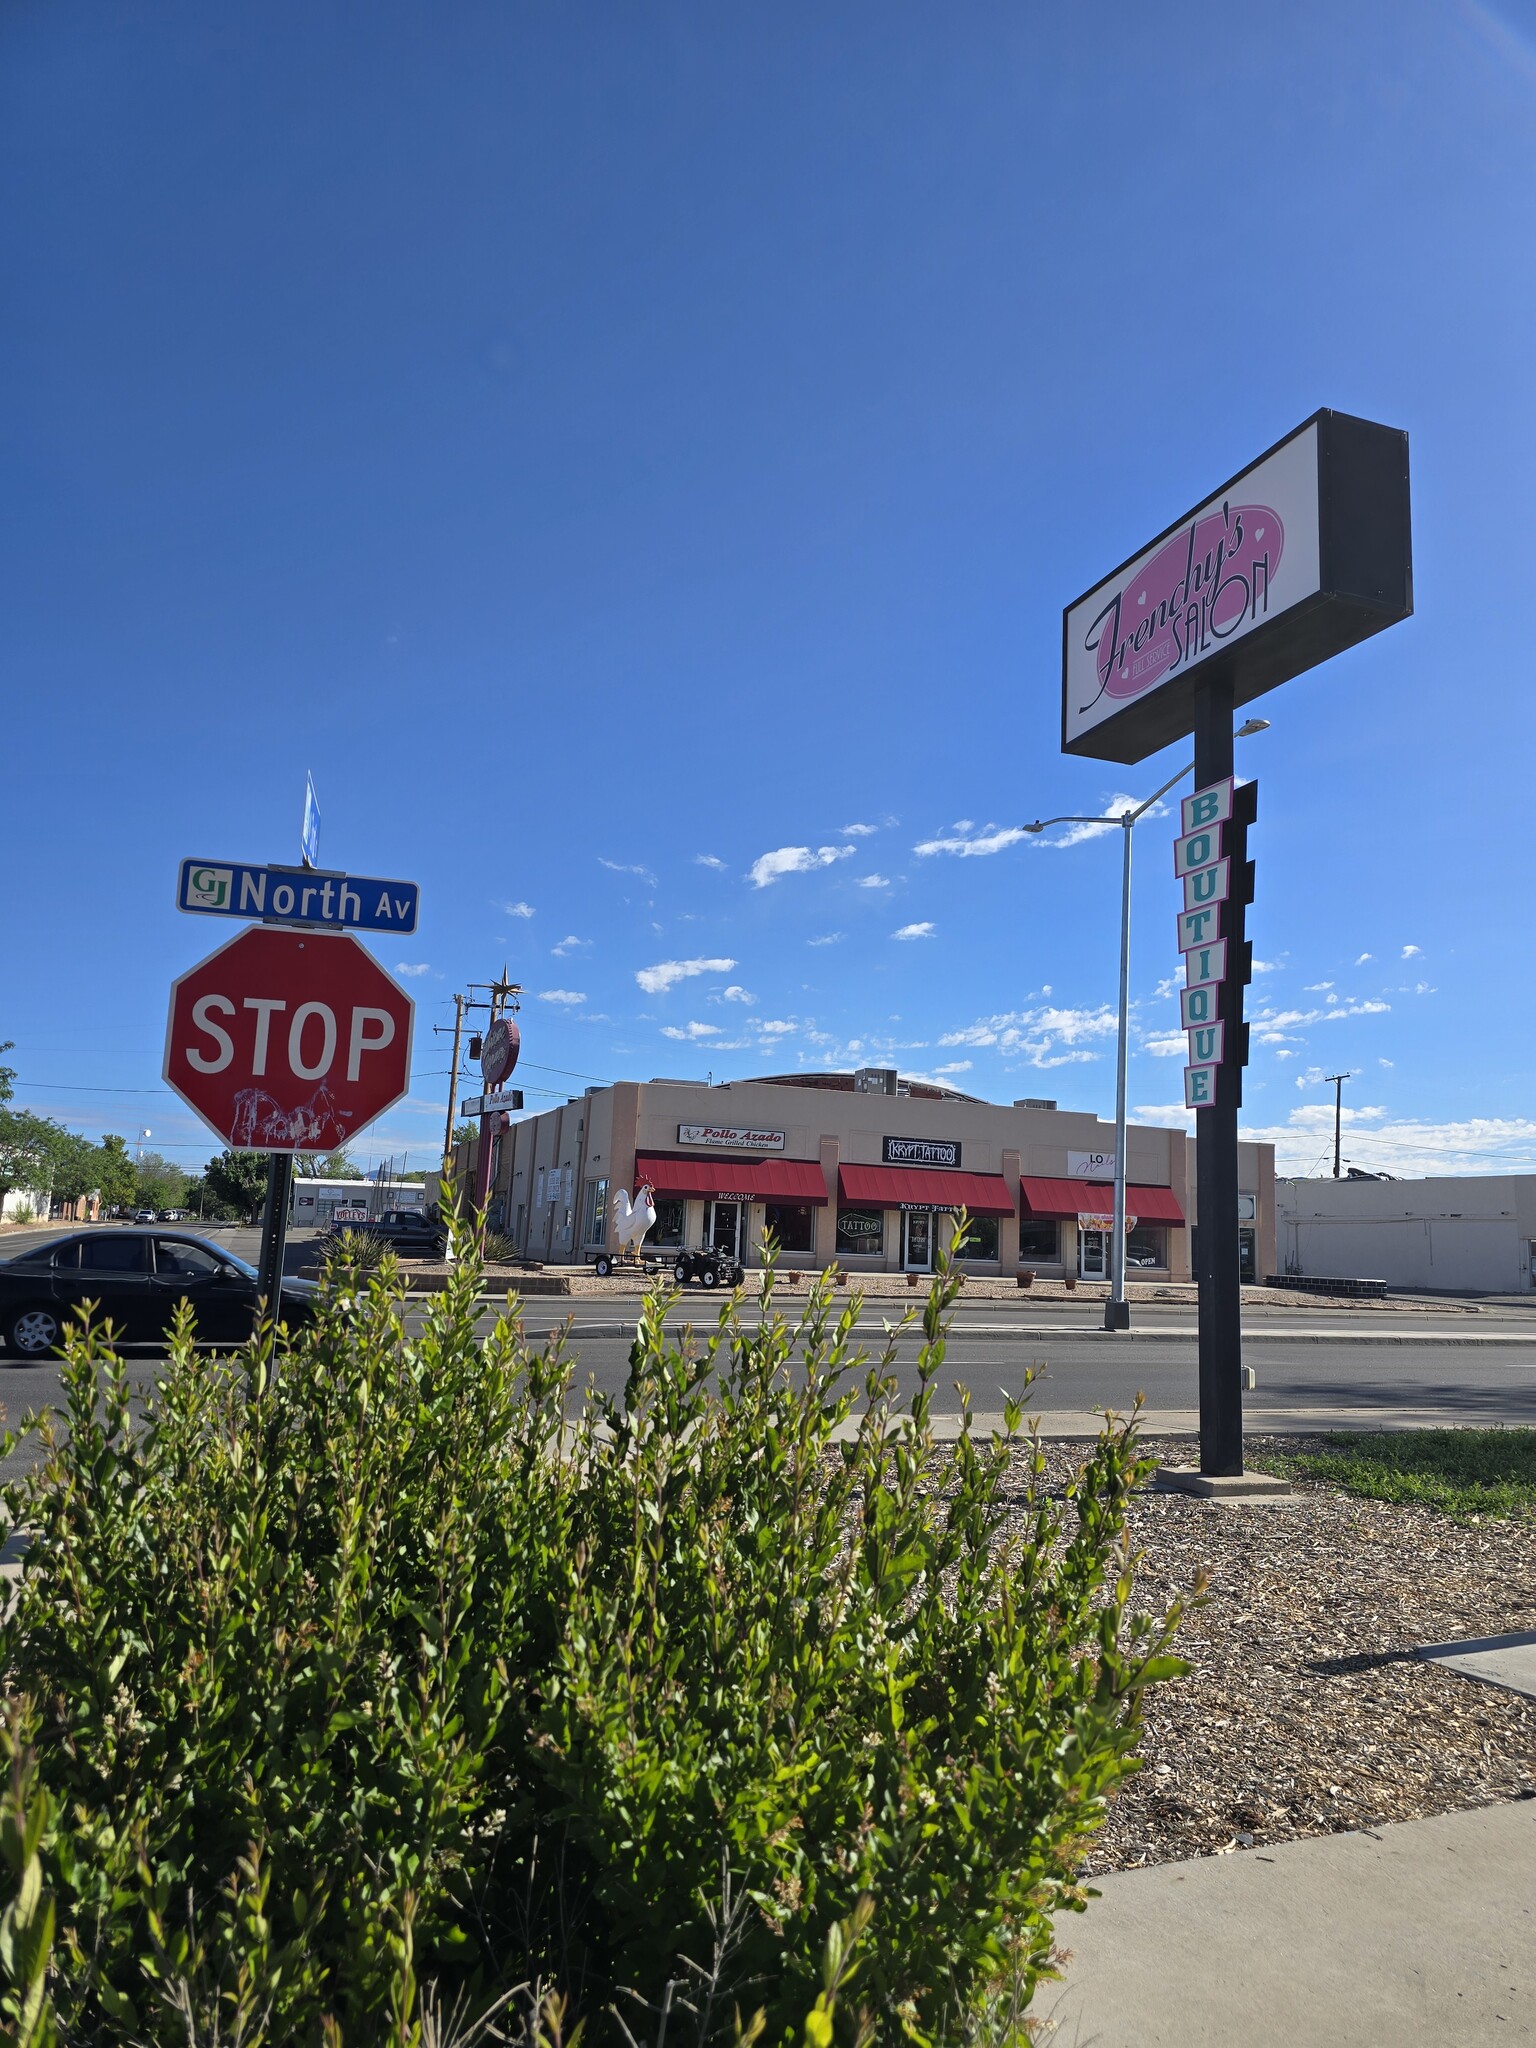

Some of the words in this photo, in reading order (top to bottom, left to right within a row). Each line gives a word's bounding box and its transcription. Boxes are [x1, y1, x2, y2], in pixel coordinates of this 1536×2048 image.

[1078, 500, 1244, 715] Frenchy's
[1169, 552, 1269, 671] SALON
[1132, 659, 1147, 676] FULL
[1147, 643, 1170, 668] SERVICE
[239, 871, 361, 921] North
[375, 892, 411, 920] Av
[1185, 791, 1220, 1103] BOUTIQUE
[185, 993, 396, 1082] STOP
[701, 1128, 737, 1139] Pollo
[740, 1131, 782, 1143] Azado
[725, 1139, 744, 1147] Grilled
[746, 1140, 769, 1148] Chicken
[892, 1142, 917, 1158] KRYPT
[920, 1145, 953, 1161] TATTOO
[1090, 1154, 1103, 1164] LO
[718, 1192, 755, 1201] WELCOME
[842, 1220, 878, 1231] TATTOO
[1141, 1257, 1156, 1266] OPEN
